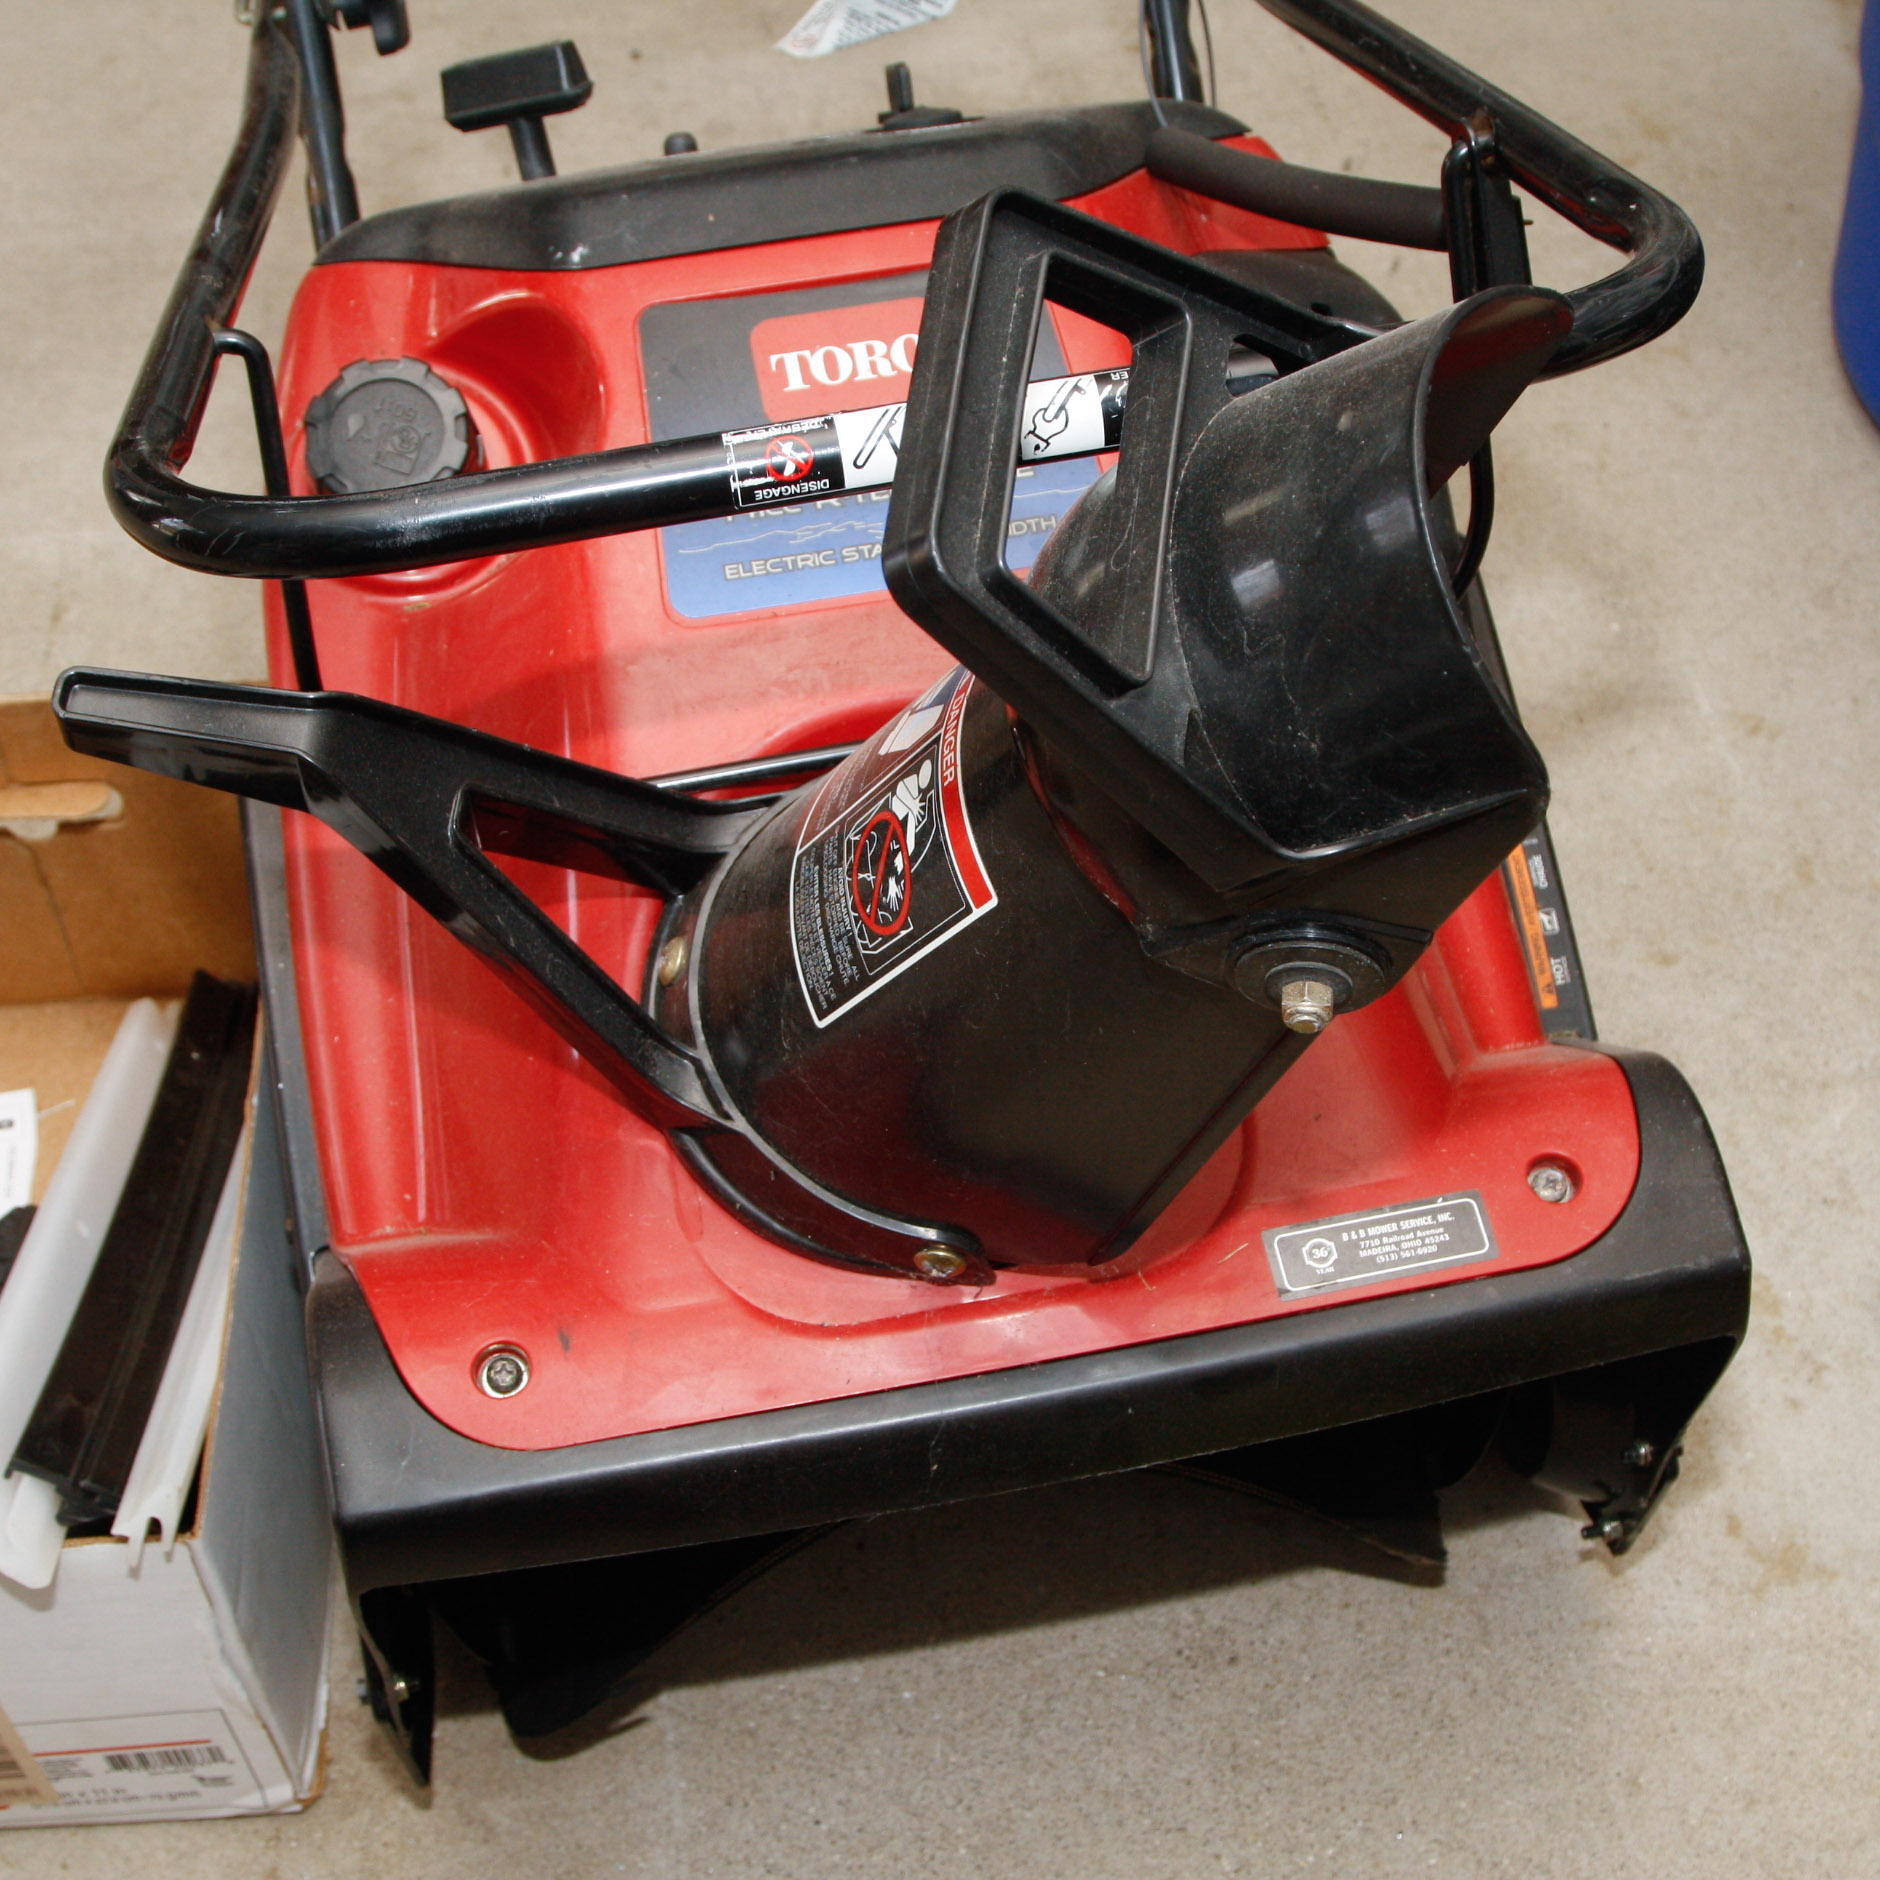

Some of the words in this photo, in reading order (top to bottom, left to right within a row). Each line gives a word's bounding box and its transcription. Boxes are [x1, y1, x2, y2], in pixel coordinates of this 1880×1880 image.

[770, 333, 919, 391] TORO
[754, 479, 830, 500] DISENGAGE
[725, 550, 836, 580] ELECTRIC
[842, 543, 883, 563] STA
[1008, 514, 1057, 536] IDTH
[943, 693, 966, 787] DANGER
[837, 864, 845, 897] AVOID
[839, 894, 851, 931] INJURY
[815, 915, 833, 973] BLESSURES
[824, 900, 839, 955] DISCHARGE
[834, 952, 850, 986] CHUTE
[836, 939, 853, 977] BEFORE
[841, 934, 853, 961] SURE
[850, 963, 861, 982] ALL
[1551, 957, 1566, 986] HOT
[1342, 1232, 1349, 1242] B
[1350, 1230, 1358, 1240] &
[1359, 1229, 1366, 1238] B
[1367, 1222, 1398, 1236] MOWER
[1400, 1216, 1436, 1230] SERVICE,
[1437, 1212, 1455, 1222] INC.
[1360, 1238, 1380, 1248] 7710
[1382, 1232, 1414, 1244] Railroad
[1416, 1227, 1444, 1237] Avenue
[1312, 1247, 1328, 1259] 36
[1360, 1244, 1400, 1258] MADEIRA,
[1401, 1239, 1422, 1249] OHIO
[1425, 1234, 1450, 1244] 45243
[1376, 1253, 1398, 1264] (513)
[1400, 1244, 1438, 1258] 561-6920
